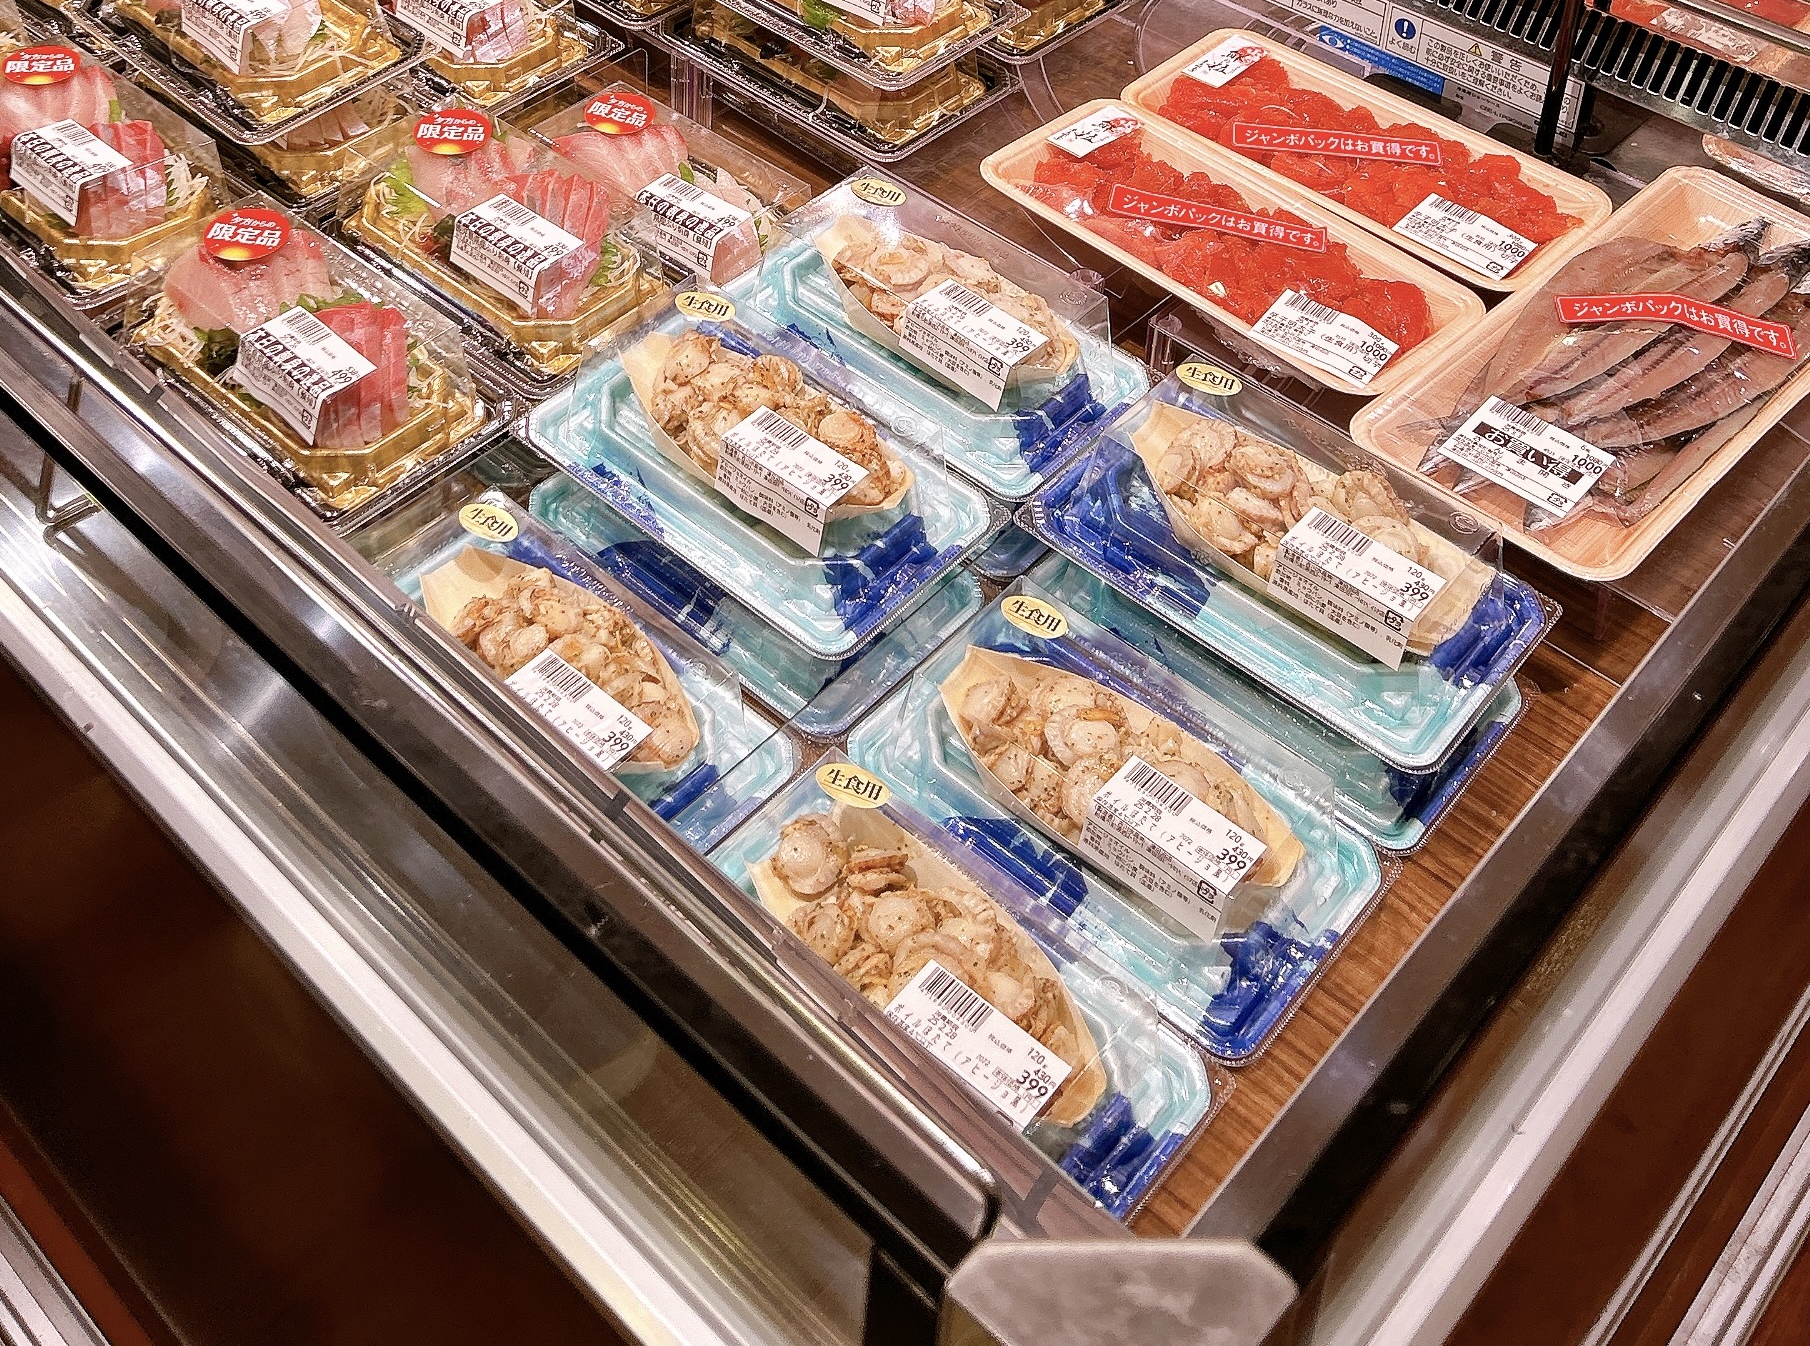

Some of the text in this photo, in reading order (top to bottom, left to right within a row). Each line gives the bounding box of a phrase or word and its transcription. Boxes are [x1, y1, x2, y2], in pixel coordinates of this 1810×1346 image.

[1388, 37, 1417, 54] よく読む
[4, 57, 76, 74] 限定品
[588, 100, 648, 128] 限定品
[416, 122, 485, 141] 限定品
[1243, 128, 1437, 162] ジャンボパックはお買得です。
[1121, 193, 1324, 248] ジャンボパックはお買得です。
[207, 222, 282, 246] 限定品
[1499, 240, 1525, 258] 1000
[1572, 299, 1788, 350] ジャンボパックはお買得です。
[1007, 337, 1030, 353] 399
[1360, 340, 1388, 362] 1000
[331, 369, 353, 384] 499
[1185, 364, 1238, 392] 生食用
[1483, 428, 1572, 479] お買い得
[1572, 453, 1603, 475] 1000
[824, 473, 850, 490] 399
[1400, 582, 1430, 602] 399
[1008, 596, 1063, 633] 生食用
[603, 731, 630, 752] 399
[826, 767, 886, 803] 生食用
[1216, 848, 1247, 872] 399
[1016, 1070, 1049, 1099] 399
